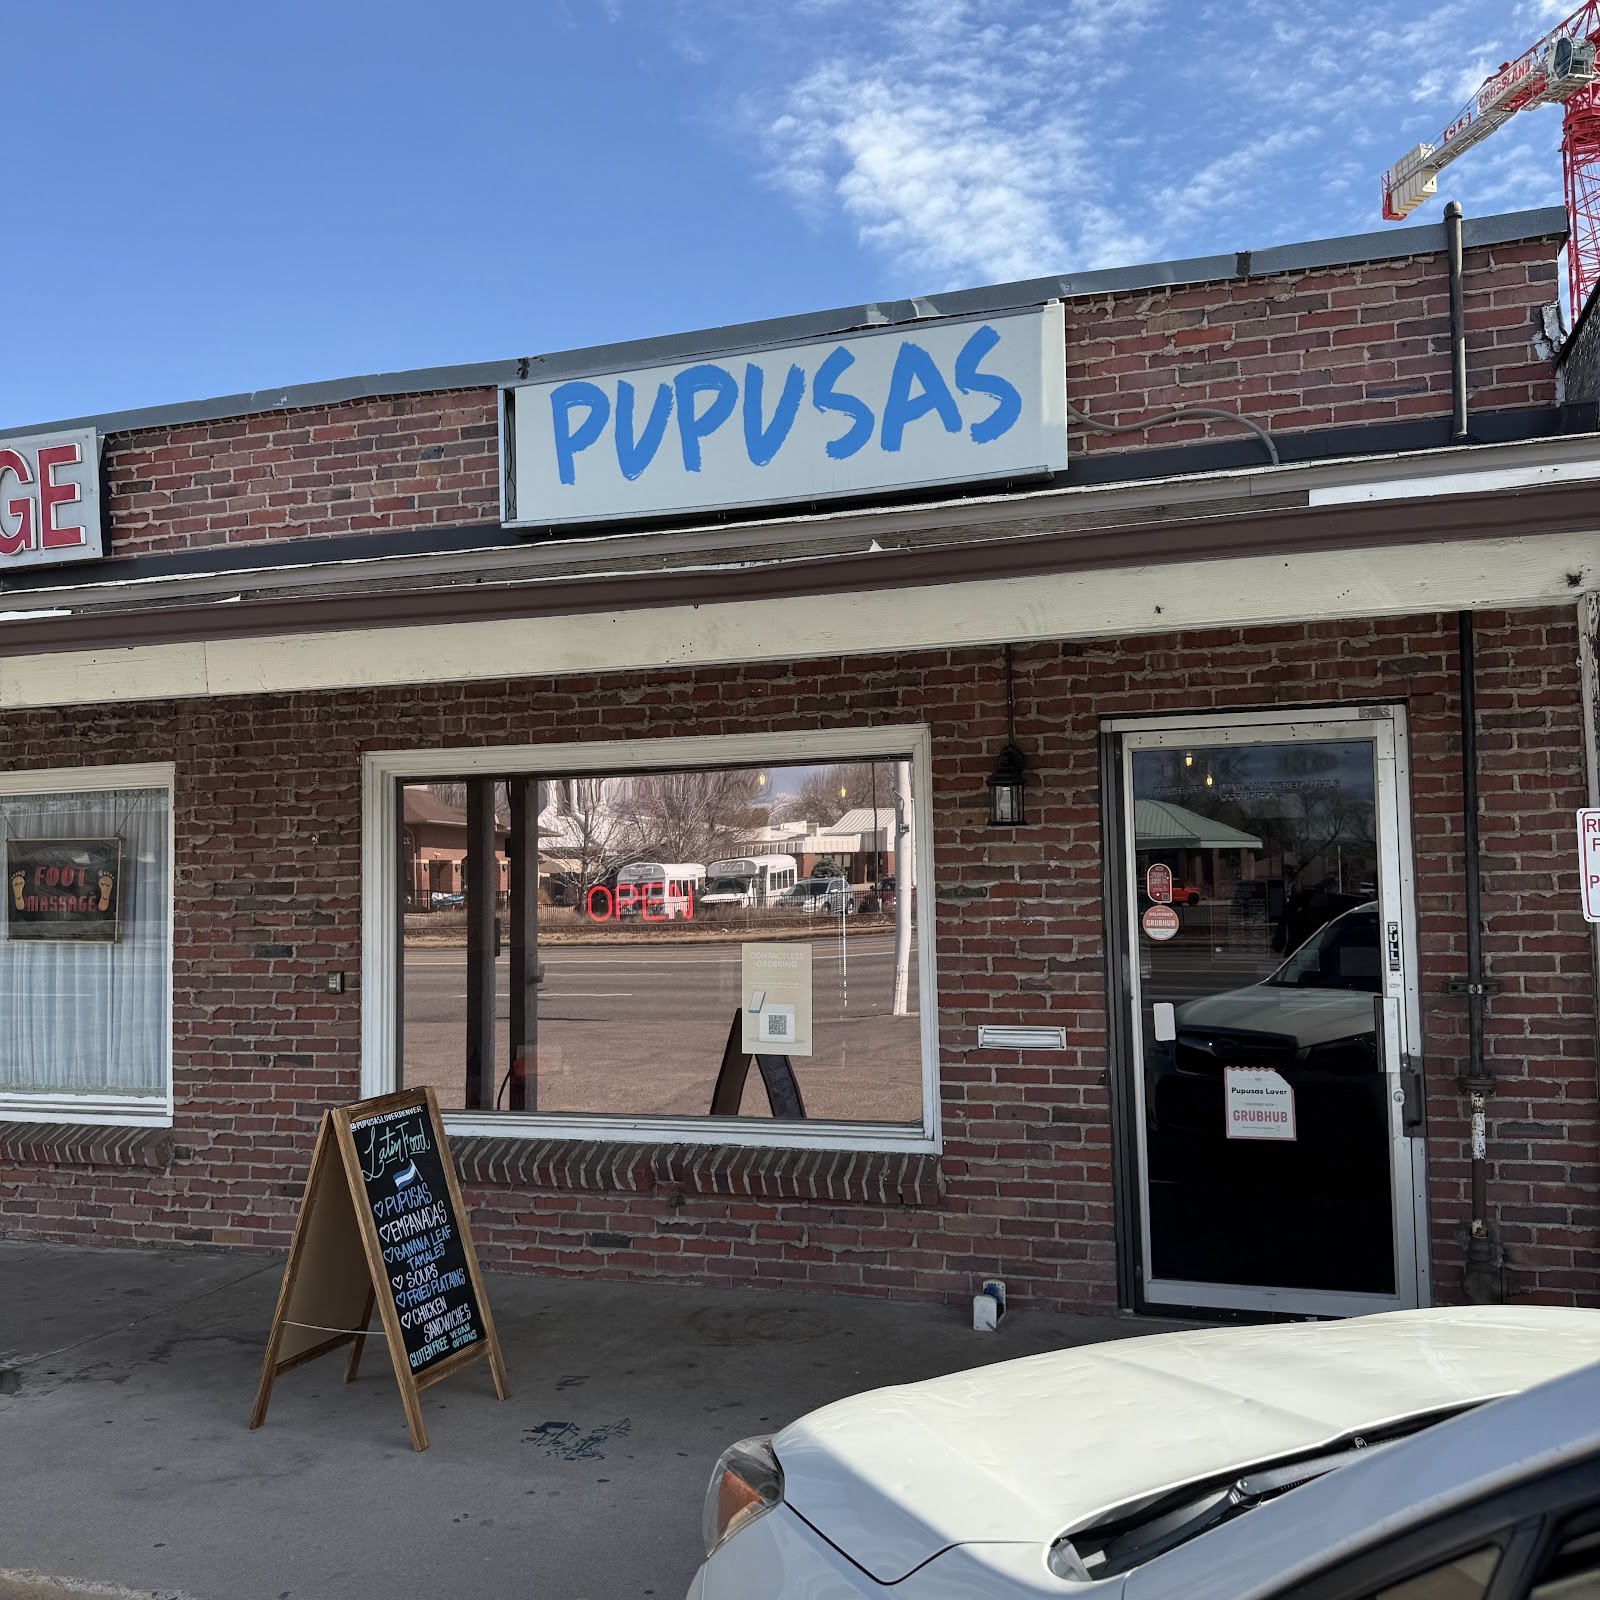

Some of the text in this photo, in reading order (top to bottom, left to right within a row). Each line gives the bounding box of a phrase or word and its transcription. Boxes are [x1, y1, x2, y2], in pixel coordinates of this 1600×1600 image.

[549, 325, 1022, 485] PUPUSAS
[0, 443, 86, 556] GE
[1587, 818, 1600, 832] R
[34, 866, 88, 887] FOOT
[26, 895, 97, 912] MASSAGE
[586, 881, 694, 922] OPEN
[1146, 919, 1176, 927] GRUBHUB
[749, 951, 804, 960] CONTACTLESS
[1388, 925, 1399, 960] PULL
[756, 960, 798, 968] ORDERING
[1231, 1087, 1288, 1095] Pupusas Lover
[1232, 1109, 1288, 1123] GRUBHUB
[361, 1125, 405, 1182] Latin
[384, 1182, 432, 1216] PUPUSAS
[389, 1200, 448, 1243] EMPANADAS
[393, 1224, 452, 1261] BANANA LEAF
[406, 1242, 446, 1271] TAMALES
[405, 1262, 439, 1288] SOUPS
[406, 1283, 432, 1307] FRIED
[412, 1295, 448, 1325] CHICKEN
[423, 1302, 472, 1343] SANDWICHES
[449, 1322, 471, 1339] VEGAN
[452, 1329, 478, 1348] OPTIONS
